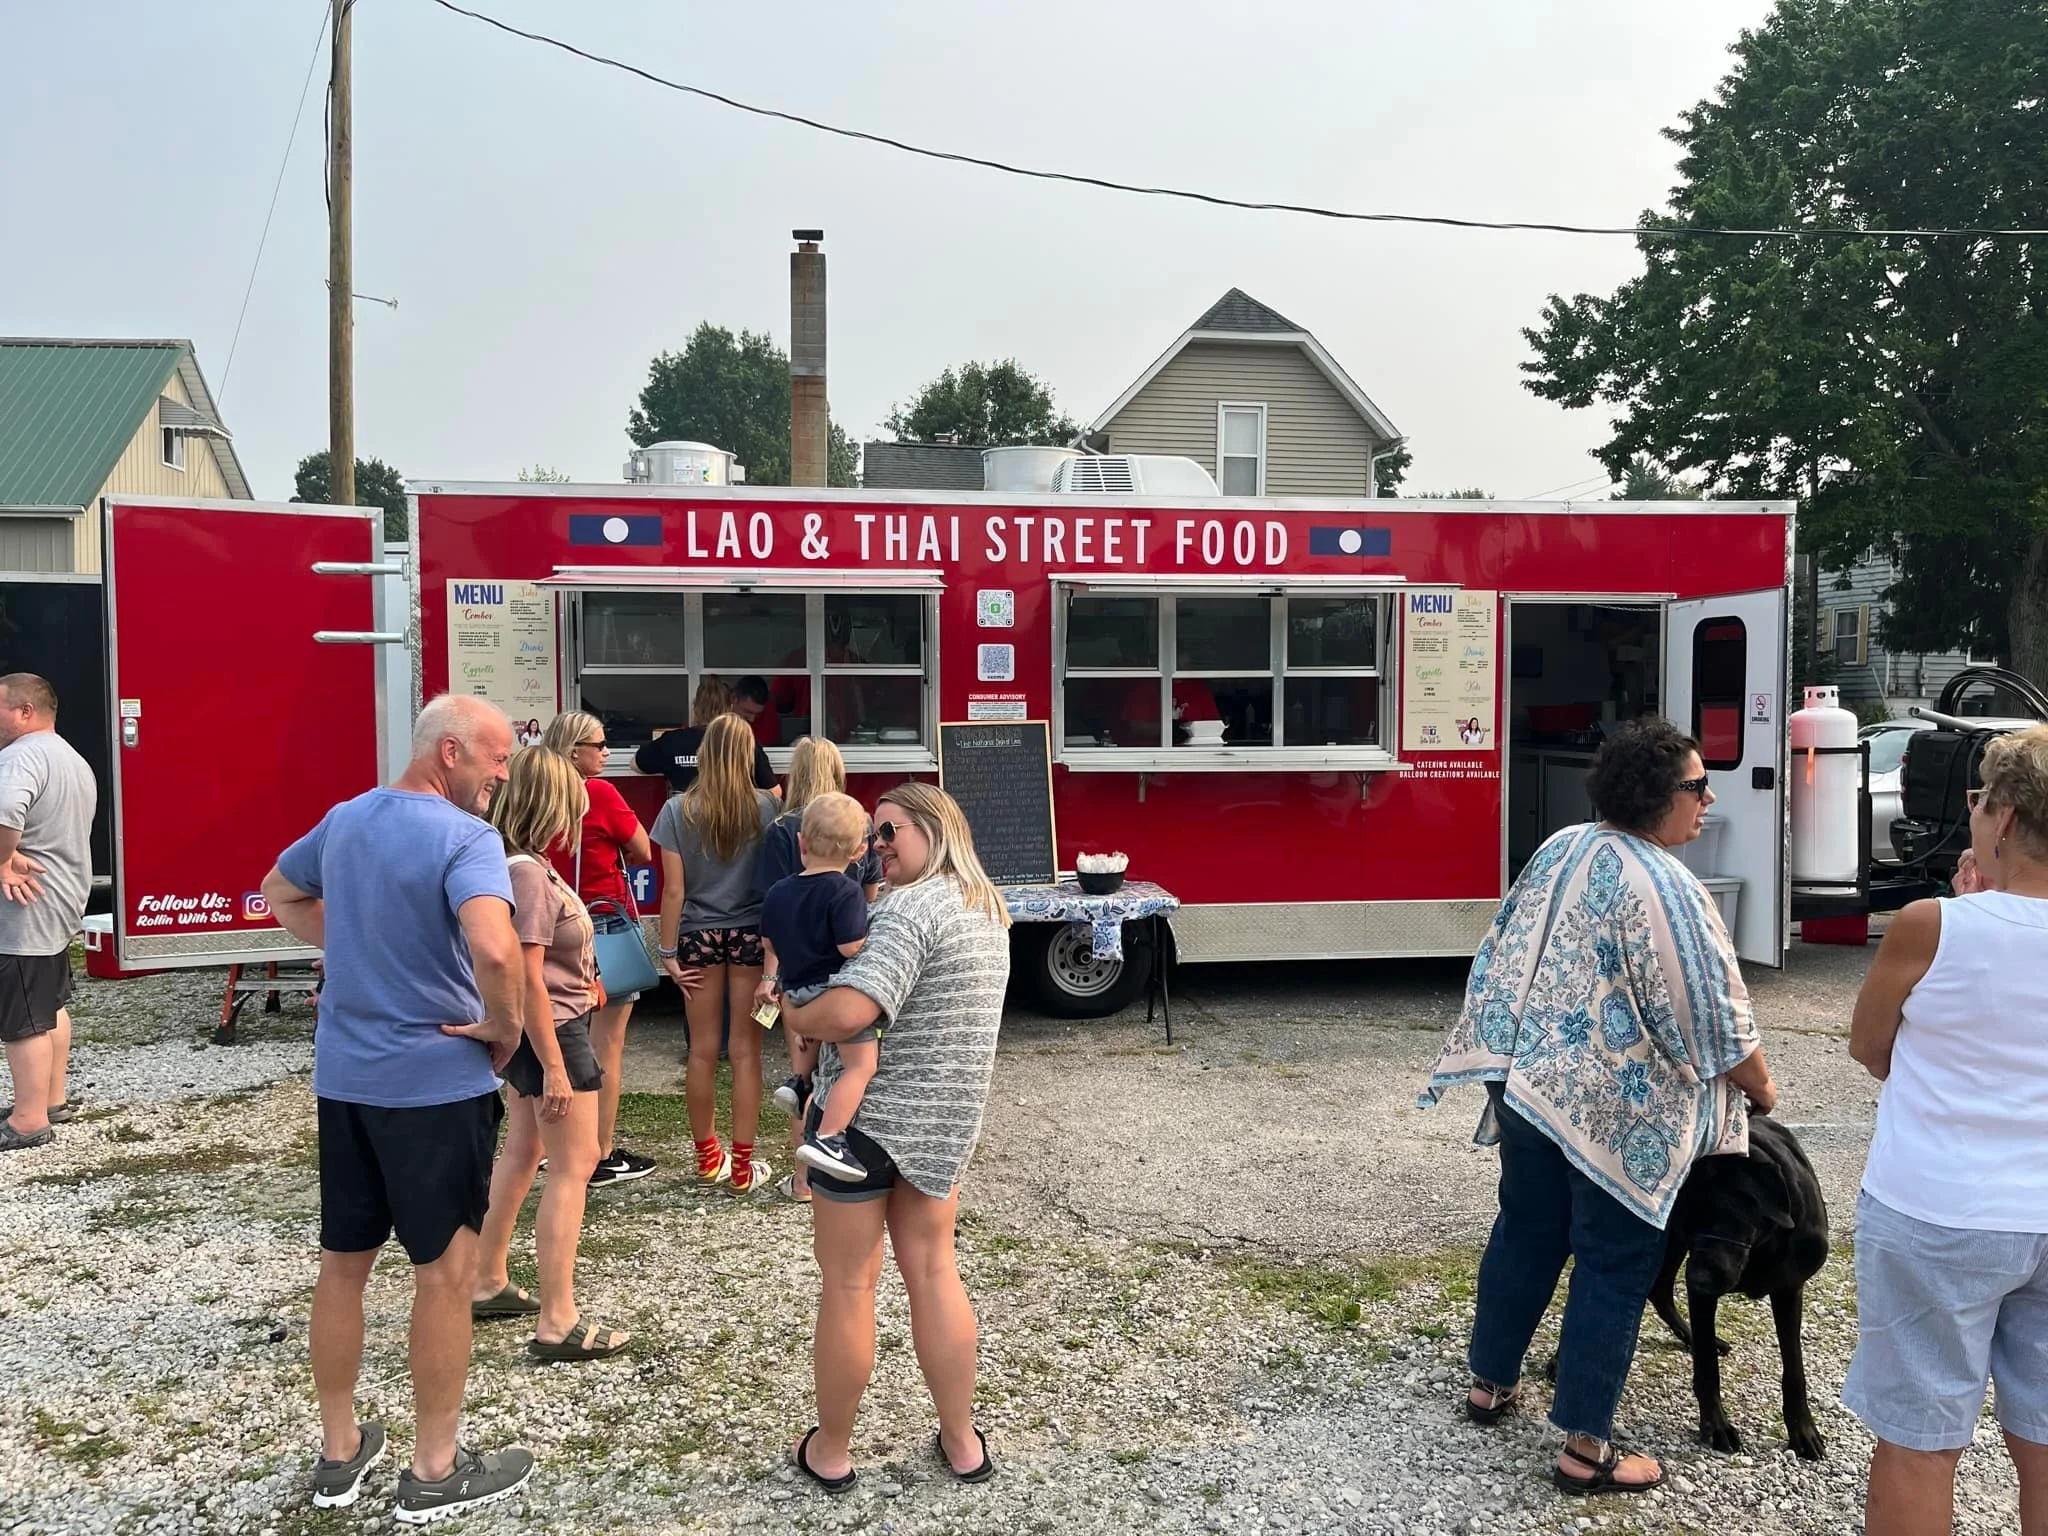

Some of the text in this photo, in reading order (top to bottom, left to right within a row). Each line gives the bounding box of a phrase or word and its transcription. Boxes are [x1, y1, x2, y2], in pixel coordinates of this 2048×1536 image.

[687, 510, 1288, 565] LAO & THAI STREET FOOD
[454, 584, 504, 605] MENU
[1411, 594, 1453, 613] MENU
[1399, 770, 1501, 778] BALLOON CREATIONS AVAILABLE
[1416, 761, 1483, 769] CATERING AVAILABLE
[138, 892, 232, 912] Follow Us:
[136, 914, 174, 927] Rollin
[177, 912, 208, 925] With
